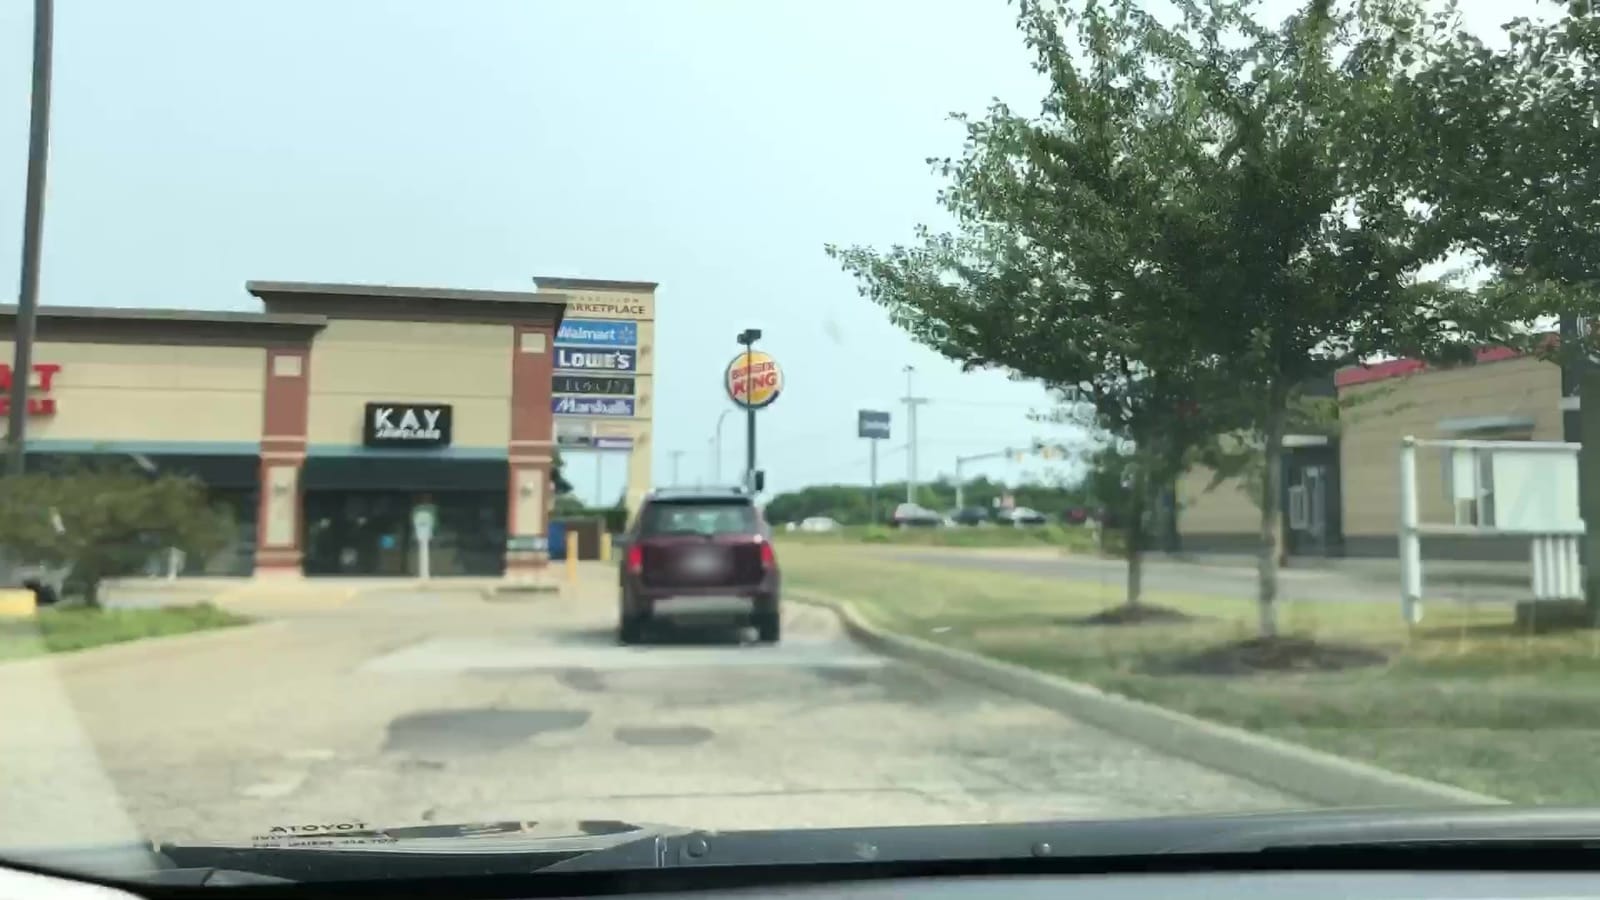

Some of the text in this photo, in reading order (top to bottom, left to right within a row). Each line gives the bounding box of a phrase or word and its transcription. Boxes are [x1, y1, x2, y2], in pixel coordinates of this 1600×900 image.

[567, 303, 645, 315] ARKETPLACE
[557, 326, 616, 340] Walmart
[559, 349, 632, 369] LOWE'S
[731, 361, 775, 380] BURGER
[733, 372, 777, 396] KNG
[554, 397, 631, 415] Marshalls
[375, 407, 441, 431] KAY
